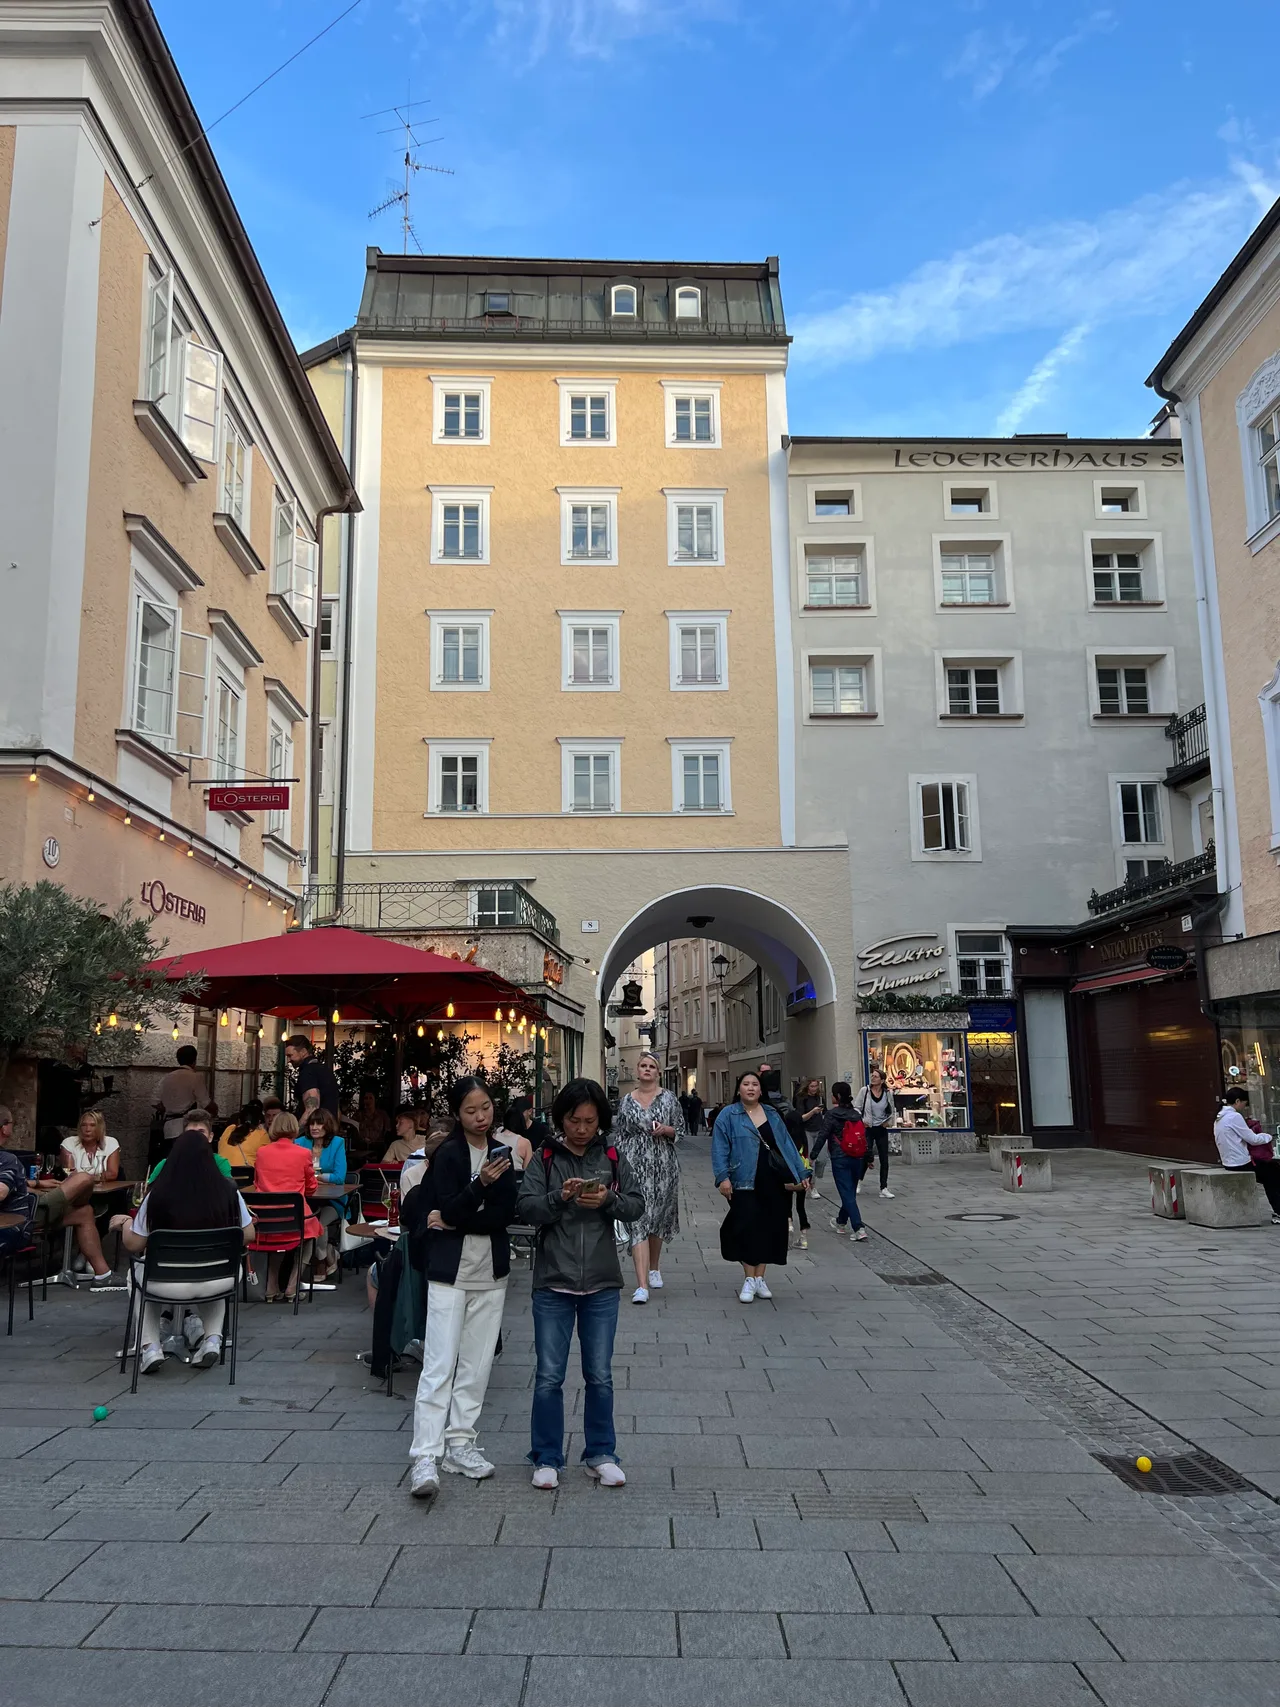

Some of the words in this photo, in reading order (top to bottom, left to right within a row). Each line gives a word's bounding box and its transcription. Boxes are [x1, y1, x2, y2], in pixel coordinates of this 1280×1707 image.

[587, 921, 593, 929] 8
[857, 932, 946, 971] Elektro
[857, 967, 946, 998] Hummer
[626, 986, 639, 1004] S
